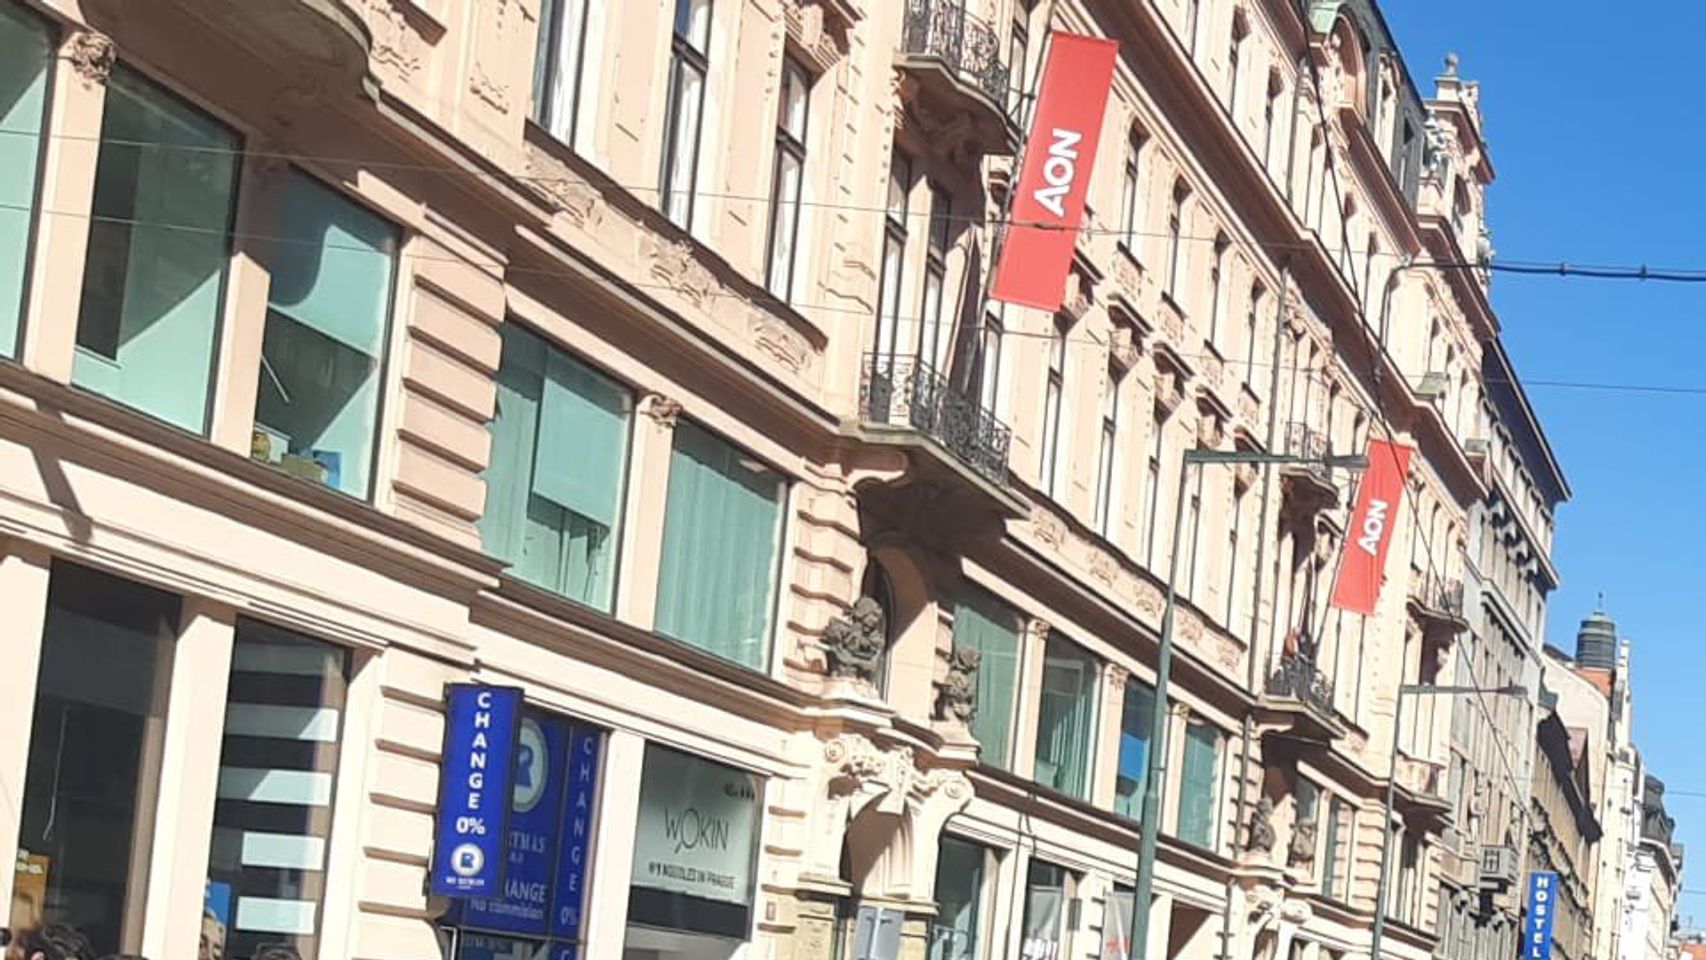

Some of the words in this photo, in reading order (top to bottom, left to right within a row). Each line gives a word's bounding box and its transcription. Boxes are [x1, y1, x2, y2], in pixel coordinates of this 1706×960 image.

[1034, 127, 1082, 217] AON
[1357, 499, 1388, 556] AON
[467, 691, 492, 810] CHANGE
[455, 816, 487, 836] 0%
[568, 736, 594, 892] CHANGE
[664, 804, 730, 854] WOKIN
[1532, 876, 1551, 958] HOSTEL
